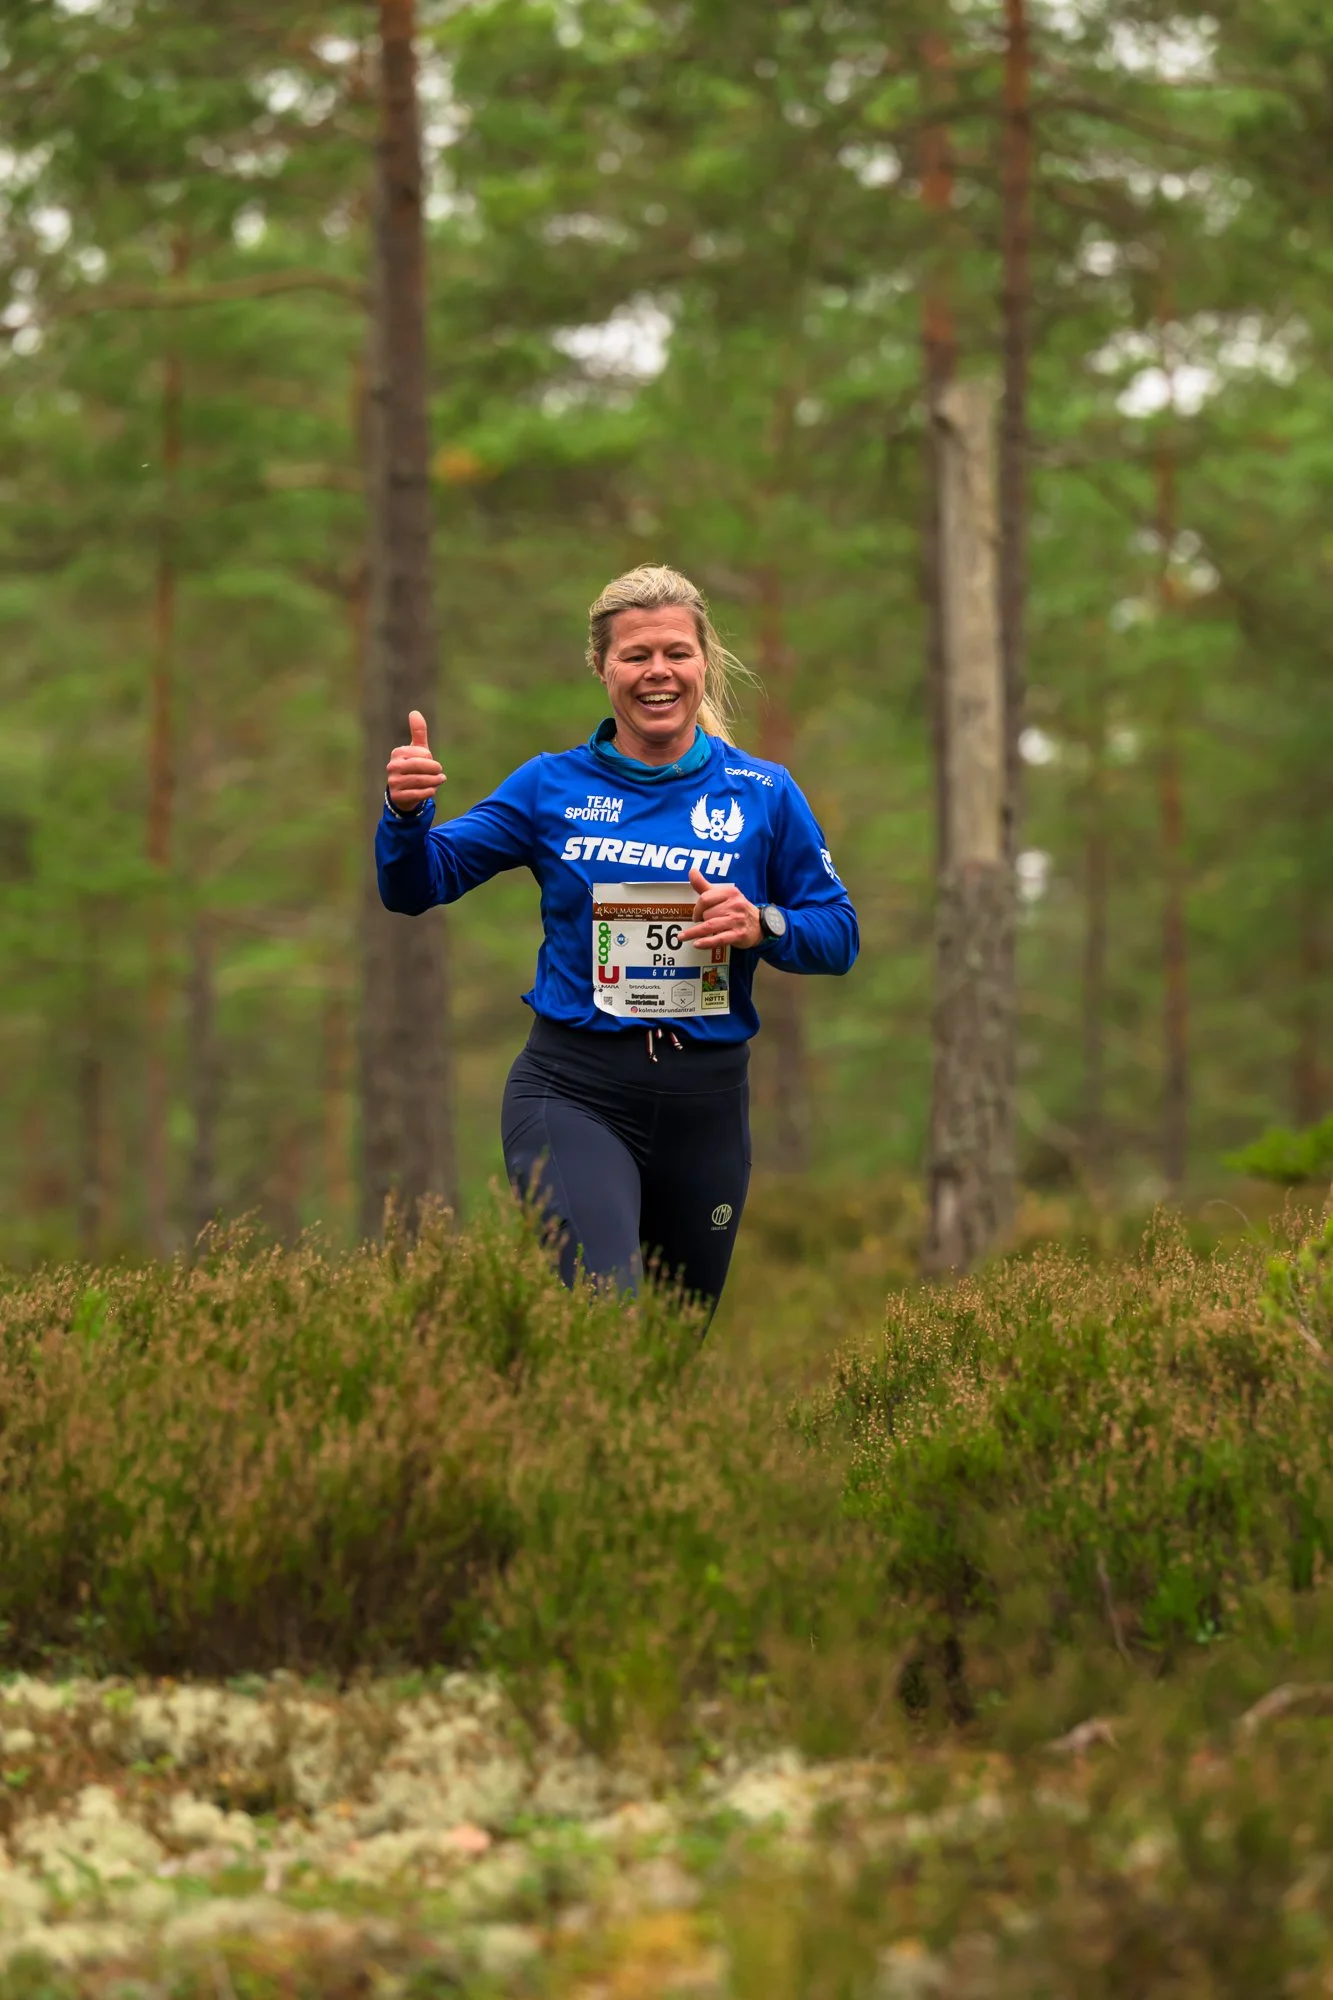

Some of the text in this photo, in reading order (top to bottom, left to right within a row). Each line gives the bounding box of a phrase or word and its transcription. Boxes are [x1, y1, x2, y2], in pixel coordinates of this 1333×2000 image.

[725, 767, 765, 781] CRAFT
[586, 795, 623, 814] TEAM
[564, 807, 620, 823] SPORTIA
[560, 836, 733, 877] STRENGTH
[598, 922, 612, 964] coop
[645, 924, 683, 951] 56
[653, 954, 675, 966] Pia
[652, 969, 657, 977] 6
